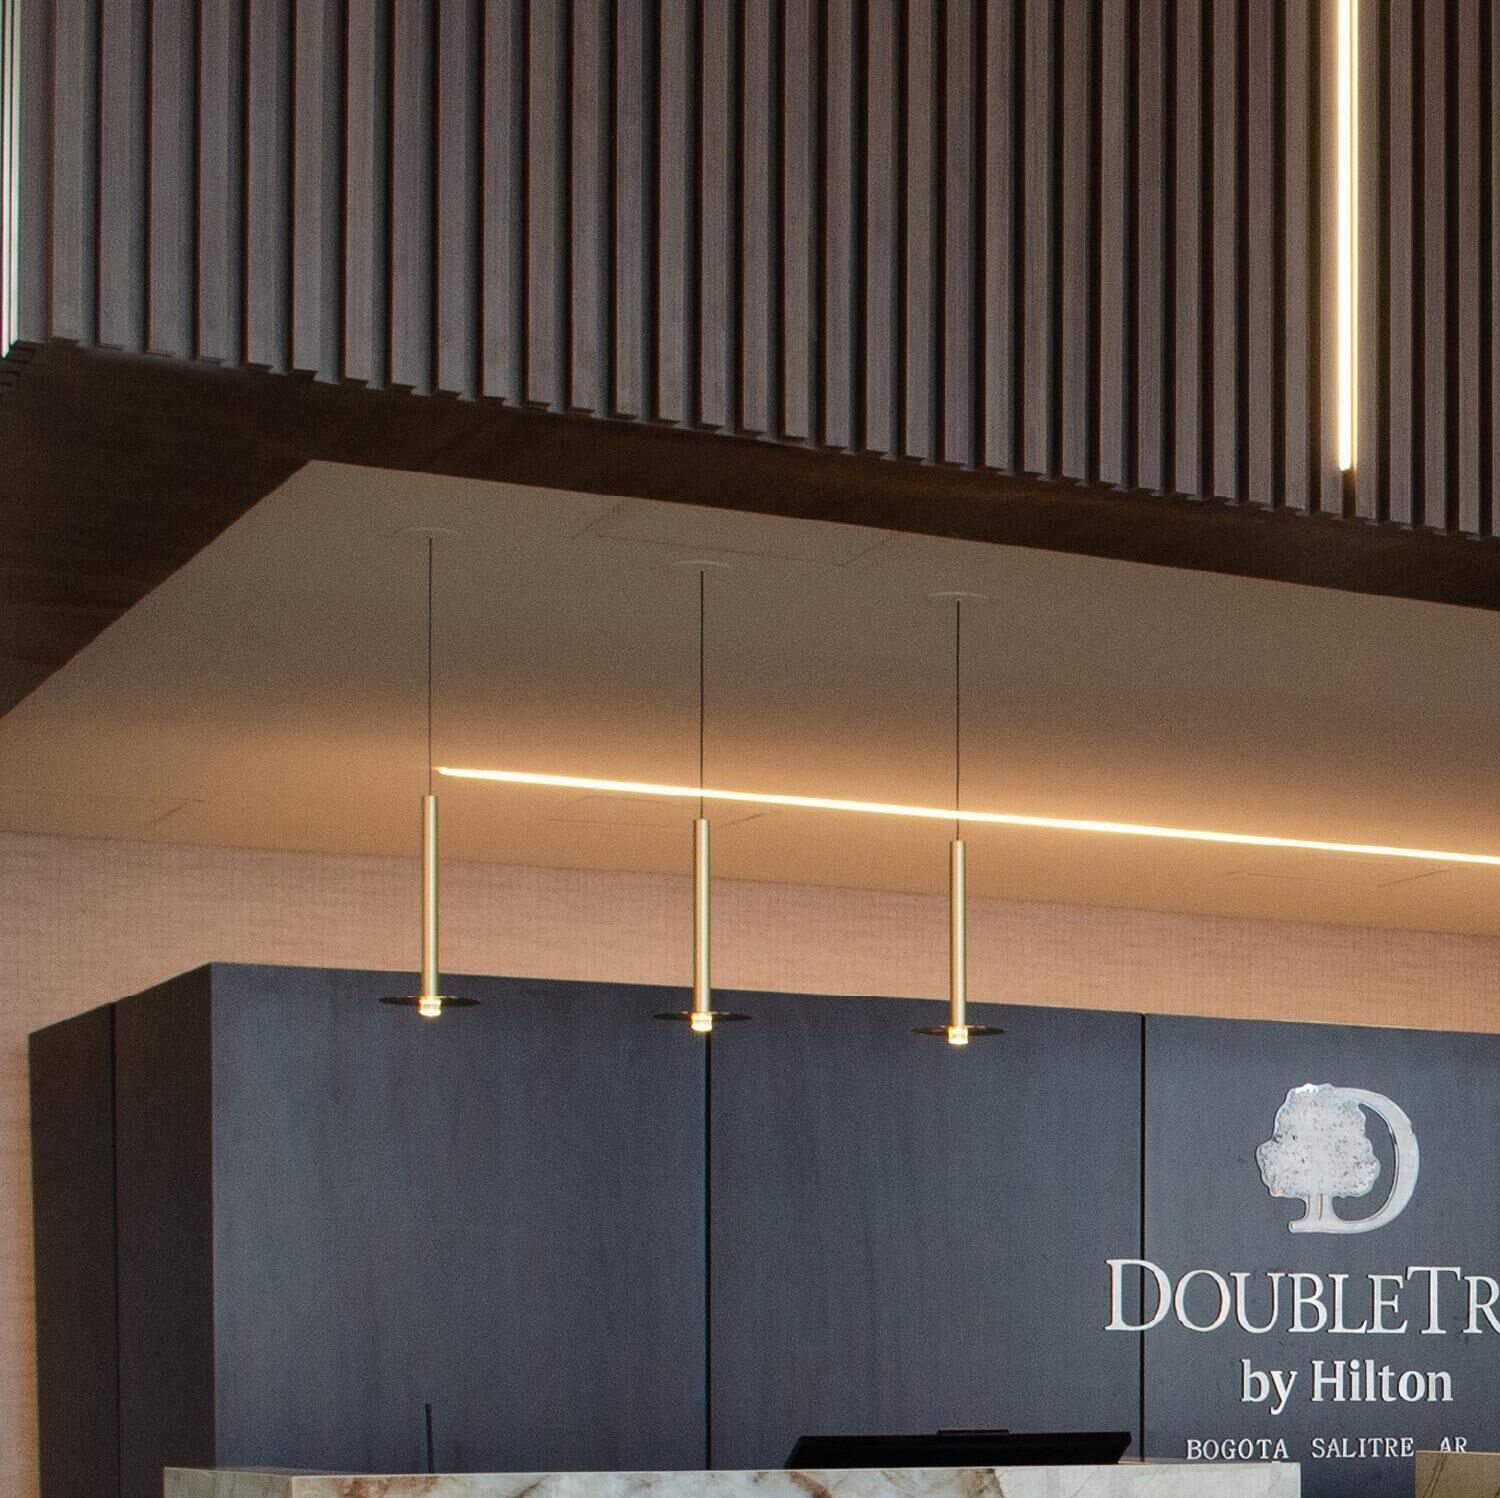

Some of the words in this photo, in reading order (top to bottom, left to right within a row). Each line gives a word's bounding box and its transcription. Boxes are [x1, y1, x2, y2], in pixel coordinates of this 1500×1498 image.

[1241, 1359, 1298, 1415] by
[1311, 1359, 1454, 1402] Hilton
[1186, 1438, 1290, 1460] BOGOTA
[1311, 1437, 1414, 1458] SALITRE
[1440, 1436, 1469, 1453] AR
